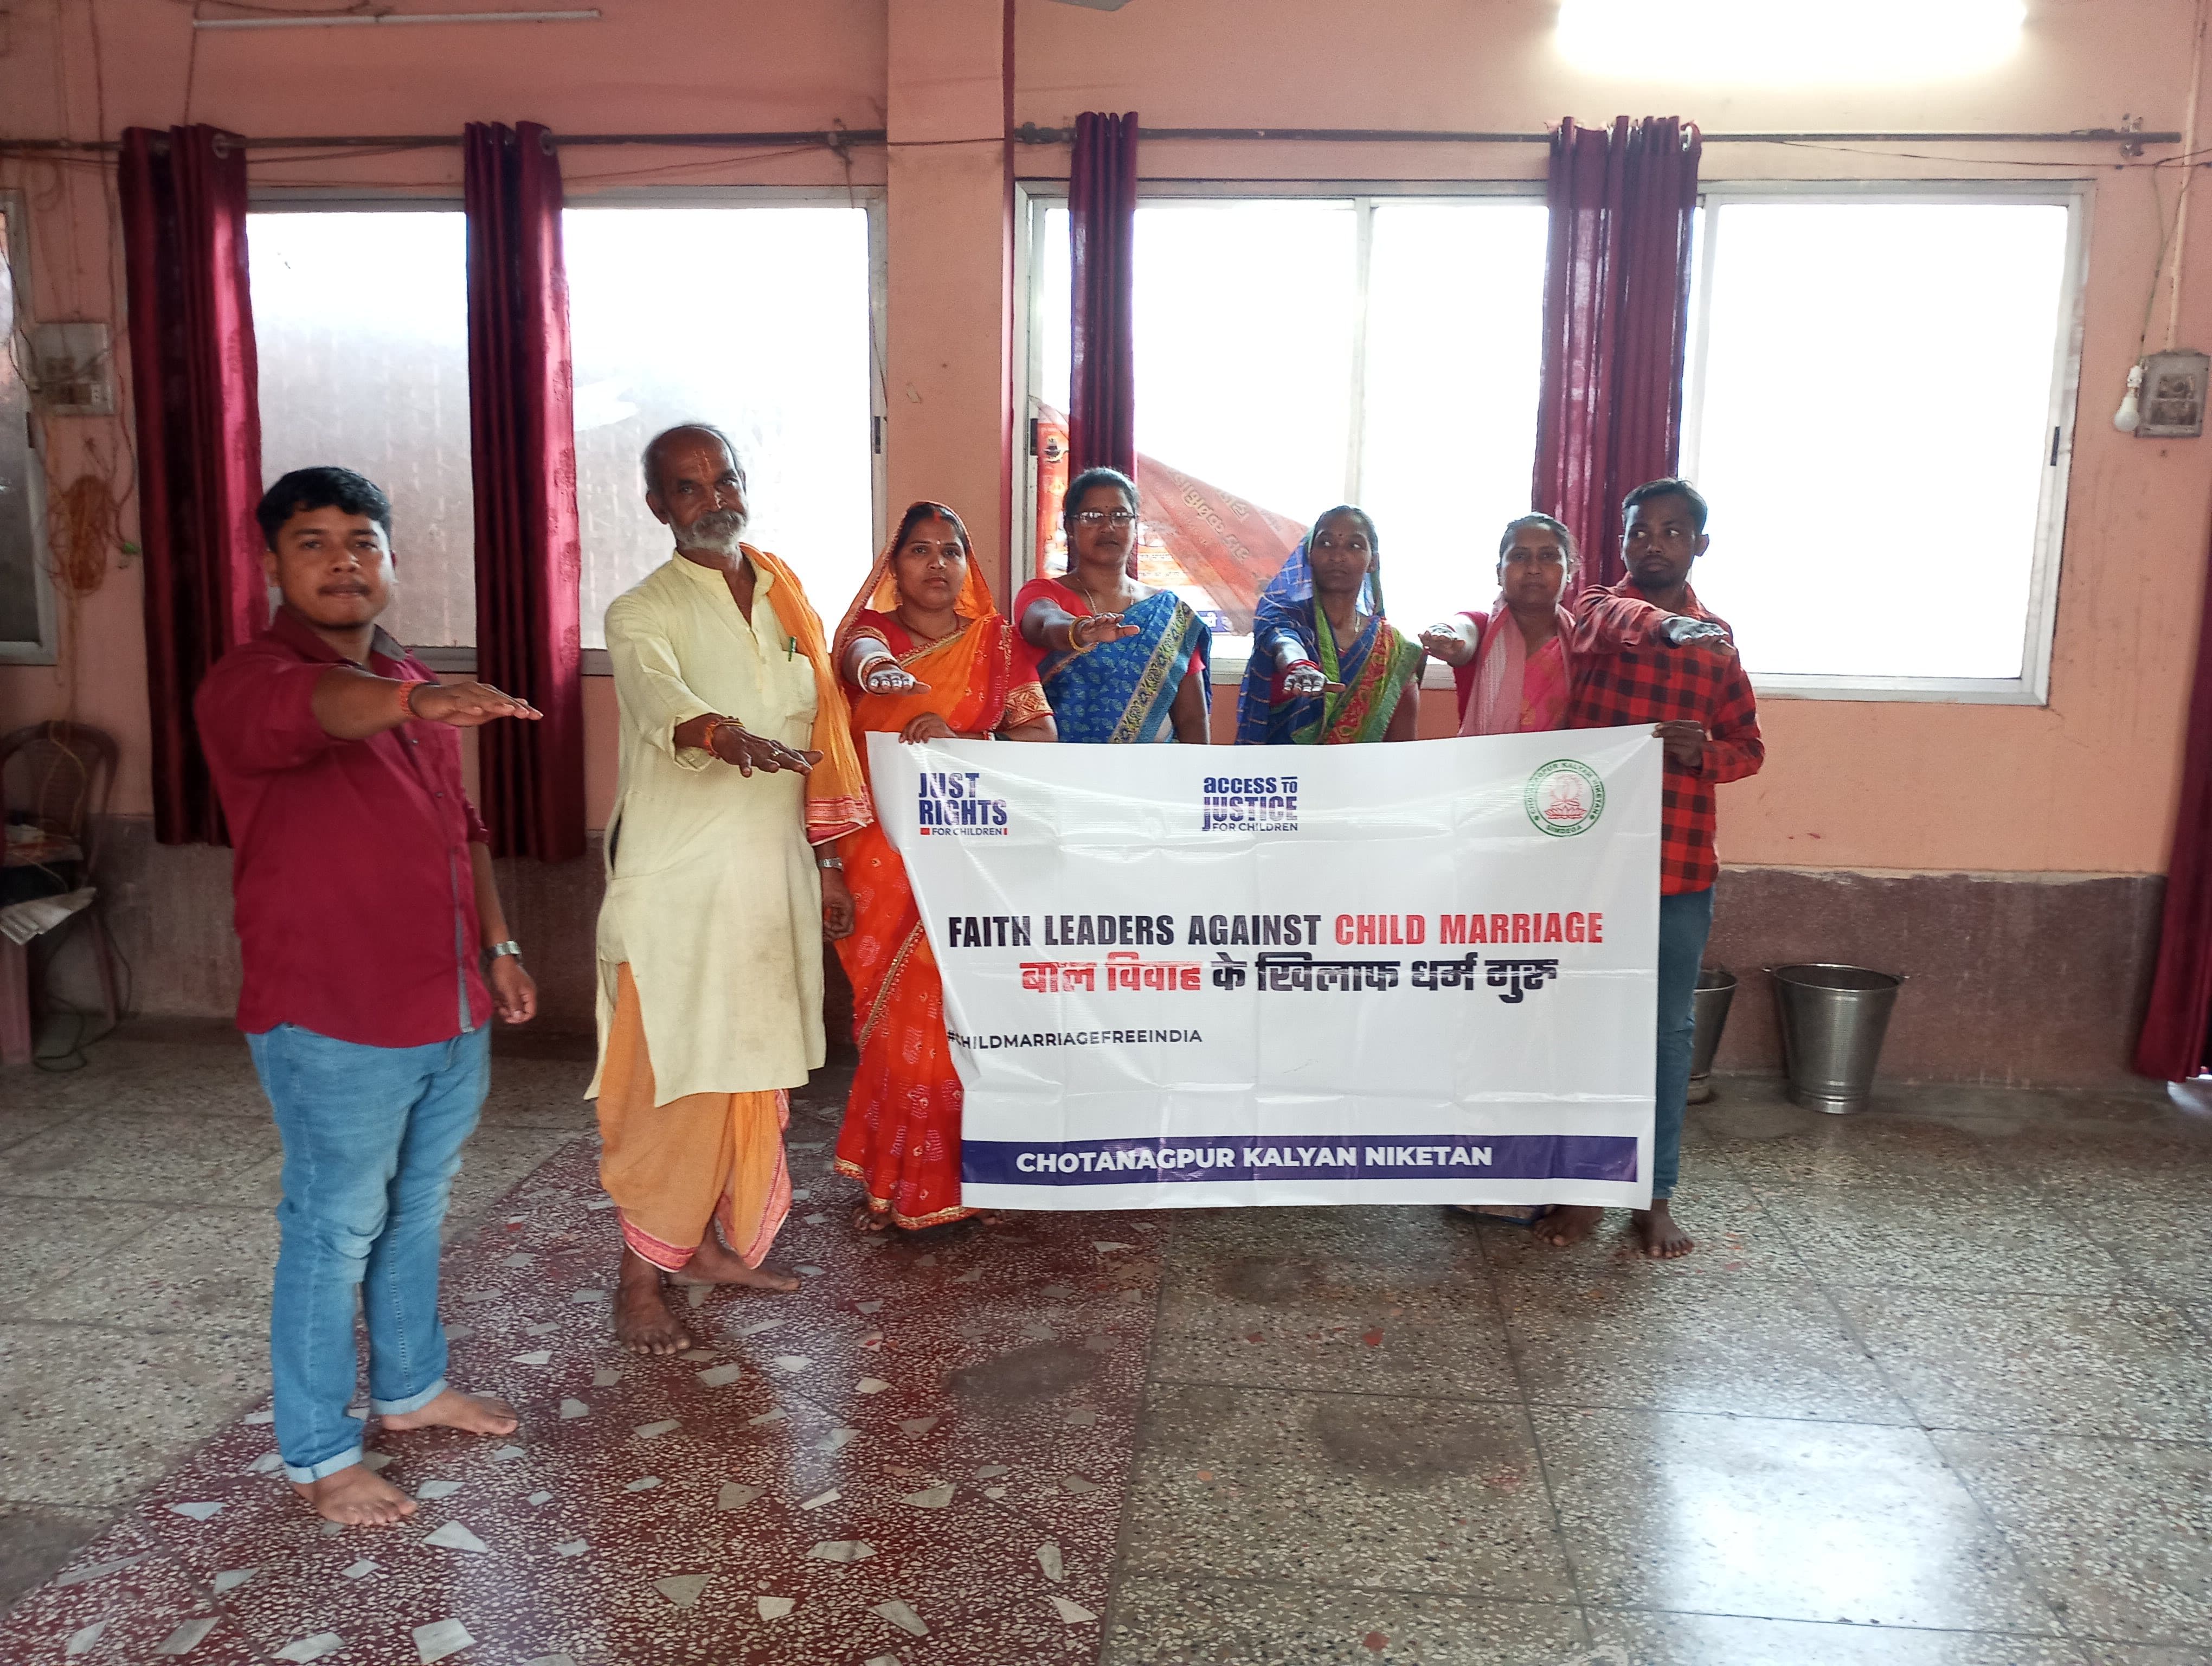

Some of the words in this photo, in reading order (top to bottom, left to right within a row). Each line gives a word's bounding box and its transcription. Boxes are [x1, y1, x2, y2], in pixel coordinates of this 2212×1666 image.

[918, 772, 980, 799] JUST
[1281, 780, 1297, 793] TO
[1592, 779, 1603, 814] NIKETAN
[918, 799, 1007, 825] RIGHTS
[1202, 796, 1297, 831] JUSTICE
[932, 828, 951, 836] FOR
[953, 827, 1002, 836] CHILDREN
[1212, 823, 1236, 831] FOR
[1238, 822, 1298, 831] CHILDREN
[948, 915, 1031, 947] FAITH
[1045, 914, 1174, 946] LEADERS
[1187, 914, 1322, 945] AGAINST
[1335, 914, 1425, 945] CHILD
[1439, 912, 1603, 945] MARRIAGE
[1019, 962, 1097, 993] बाल
[1104, 951, 1203, 991] विवाह
[1211, 952, 1248, 991] के
[1254, 951, 1401, 991] खिलाफ
[1411, 952, 1478, 991] धर्म
[1016, 1148, 1236, 1173] CHOTANAGPUR
[1243, 1146, 1357, 1167] KALYAN
[1365, 1146, 1492, 1166] NIKETAN
